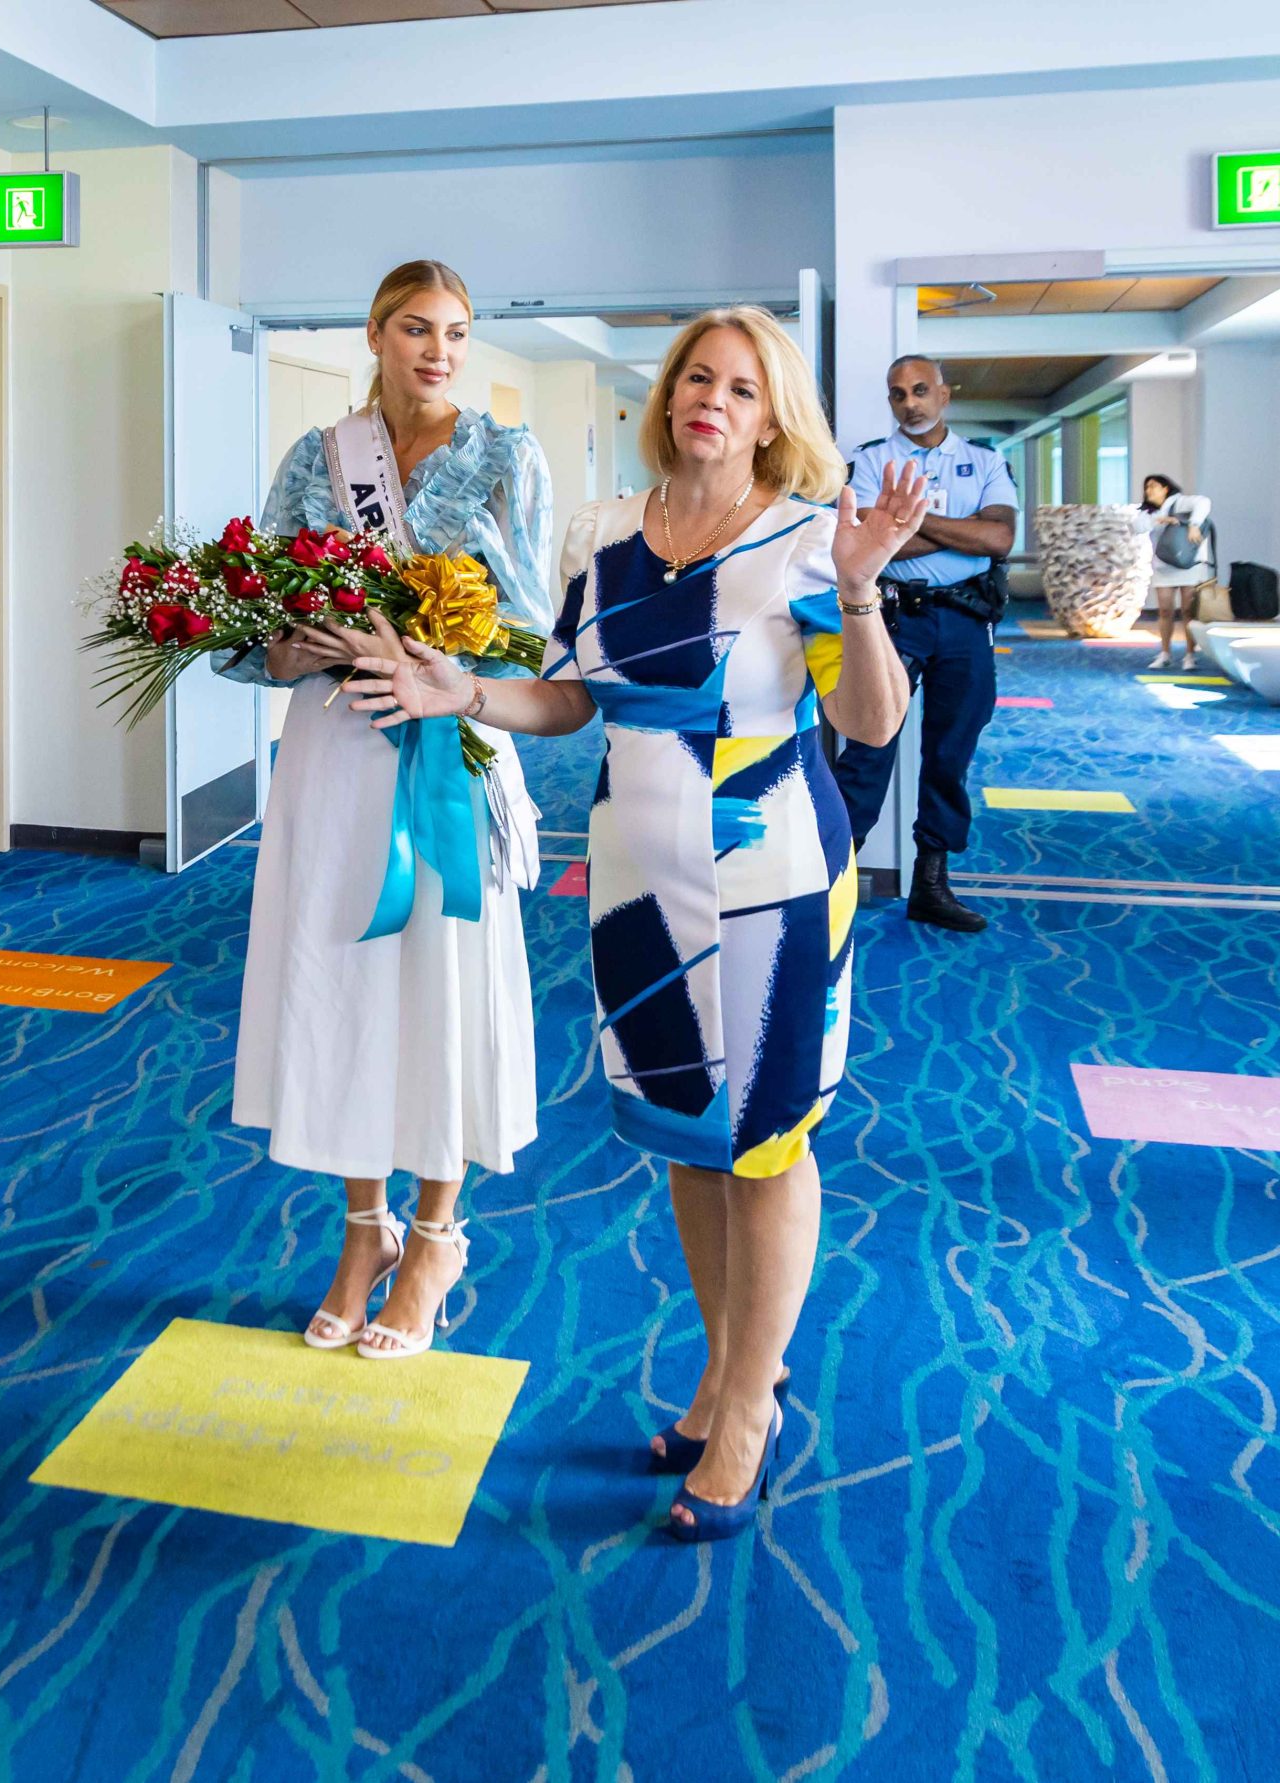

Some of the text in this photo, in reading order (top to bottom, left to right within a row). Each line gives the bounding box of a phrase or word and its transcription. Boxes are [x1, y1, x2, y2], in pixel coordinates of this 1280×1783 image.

[1101, 1076, 1212, 1093] Sand
[213, 1376, 406, 1425] Island
[99, 1402, 452, 1478] One Happy
